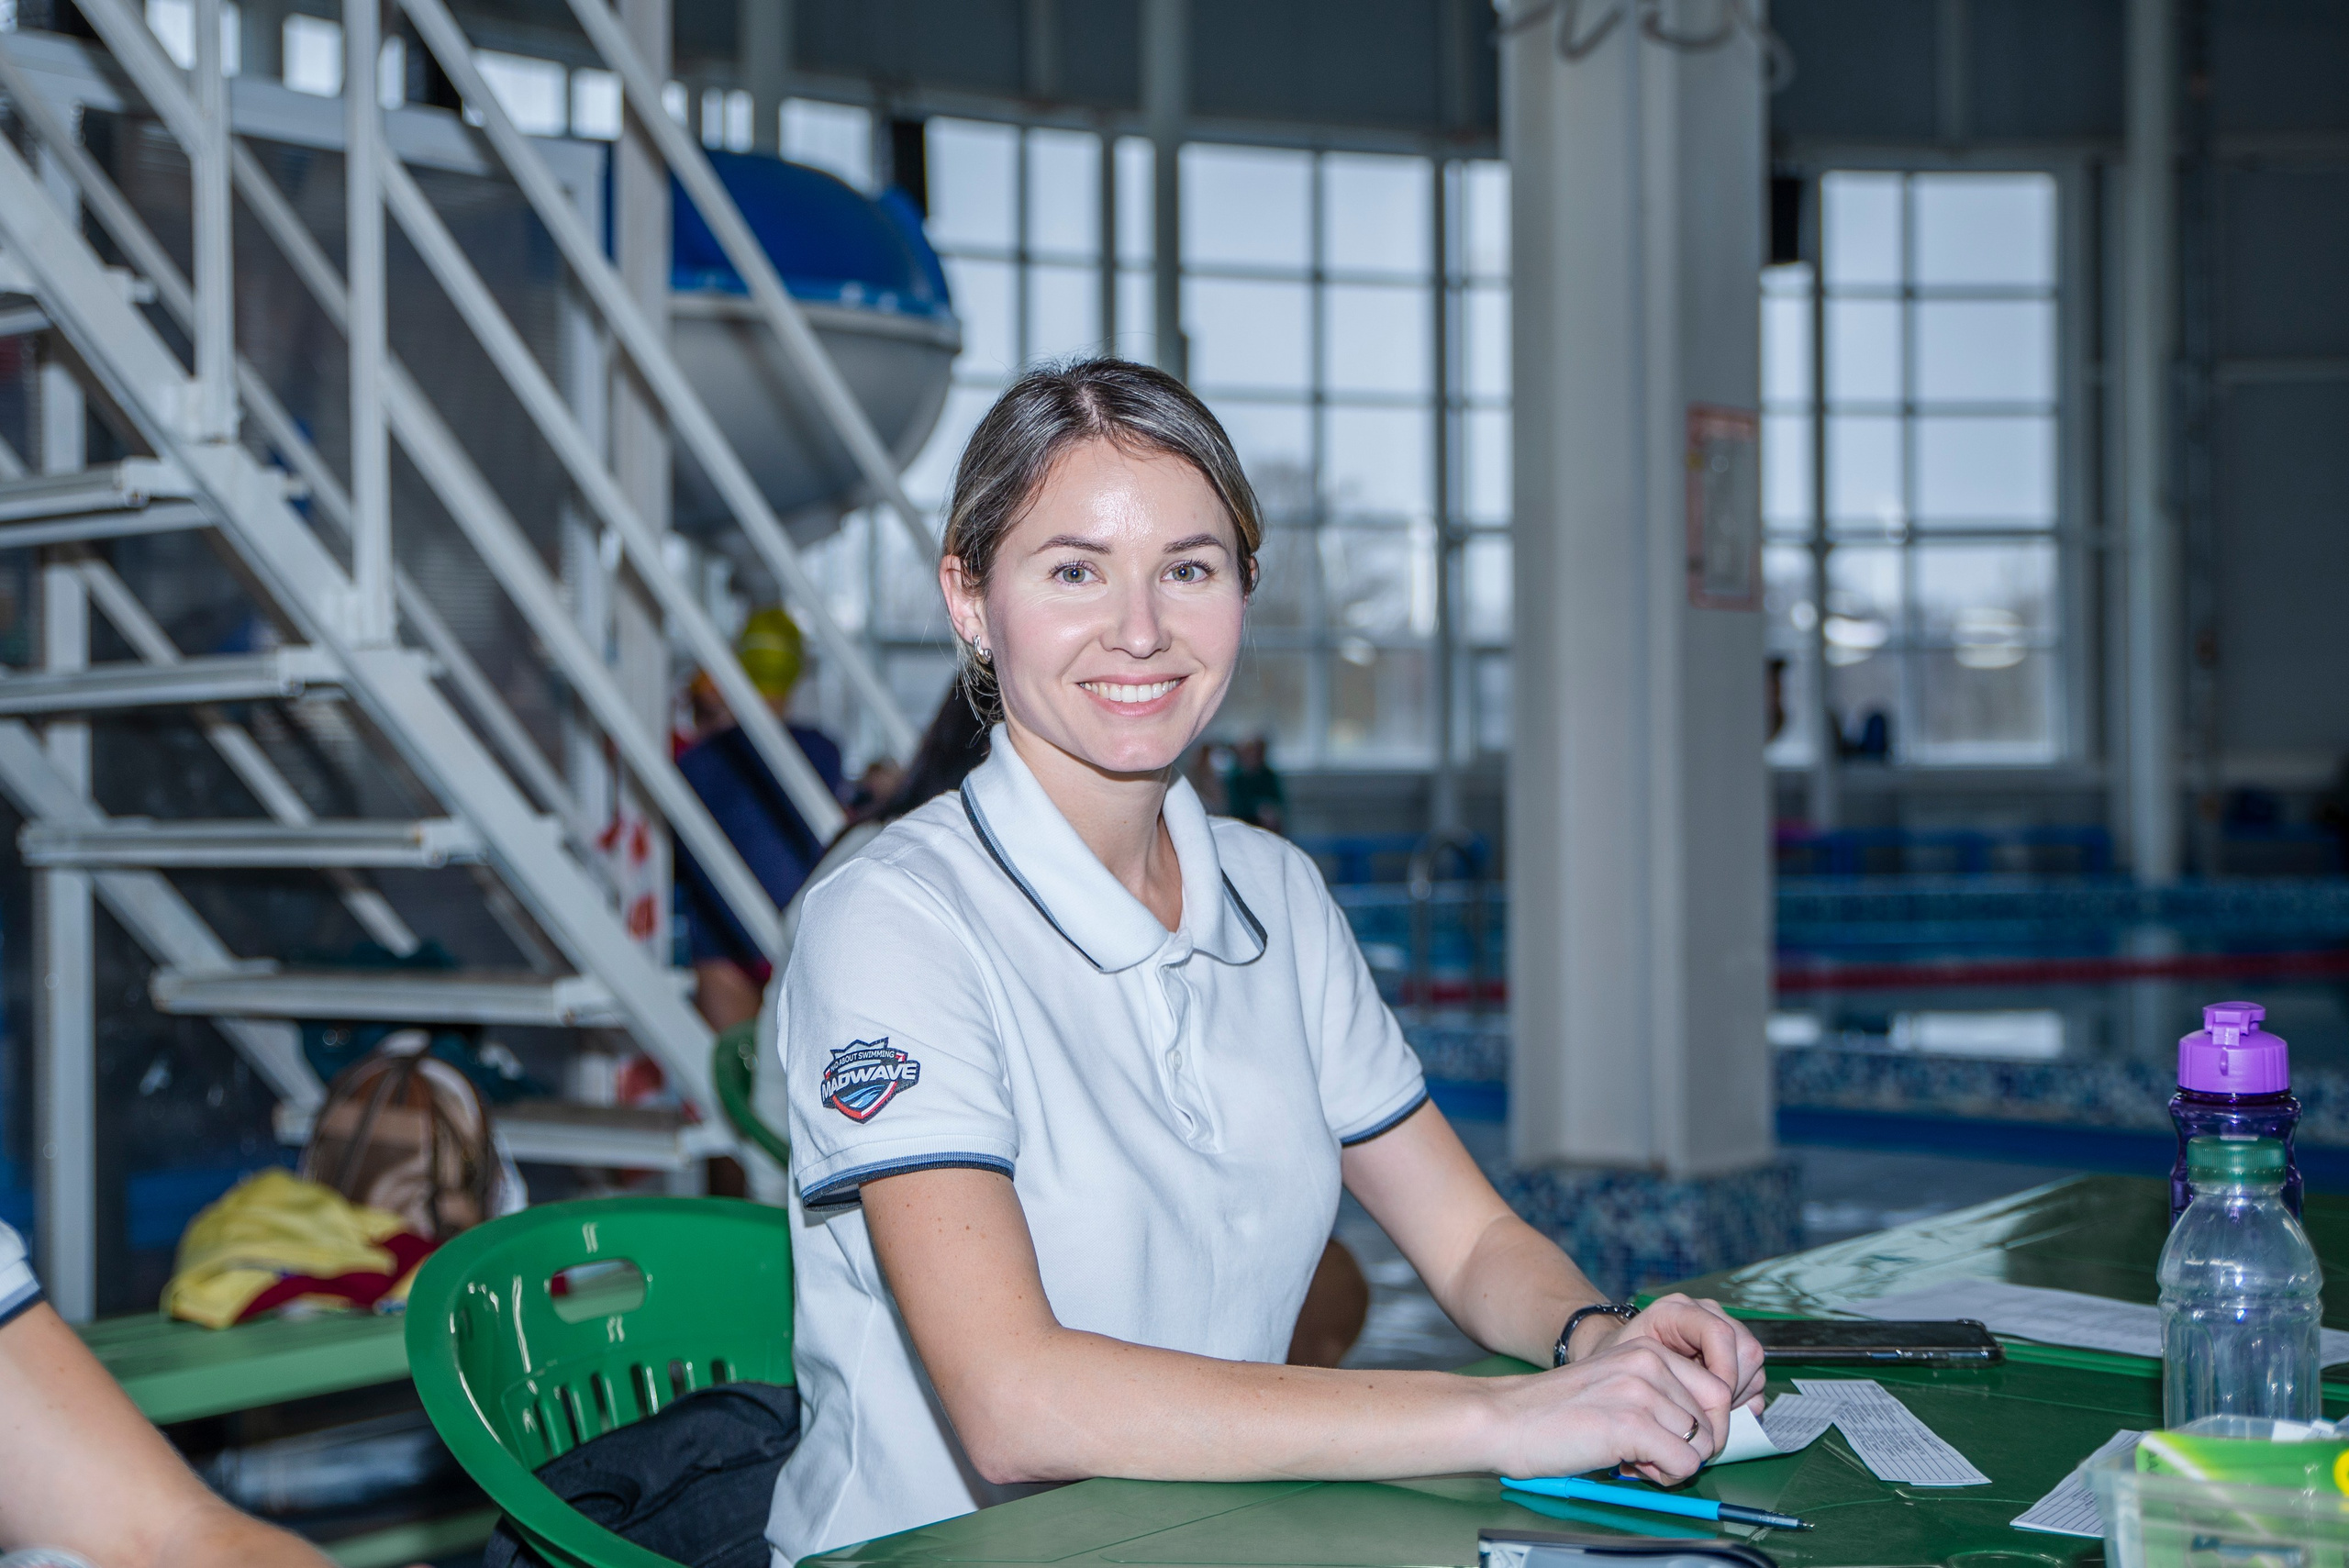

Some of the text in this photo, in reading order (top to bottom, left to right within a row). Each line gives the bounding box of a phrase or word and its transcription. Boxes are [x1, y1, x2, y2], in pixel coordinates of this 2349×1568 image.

[839, 1053, 858, 1066] ABOUT
[858, 1051, 895, 1060] SWIMMING
[821, 1063, 918, 1101] MADWAVE
